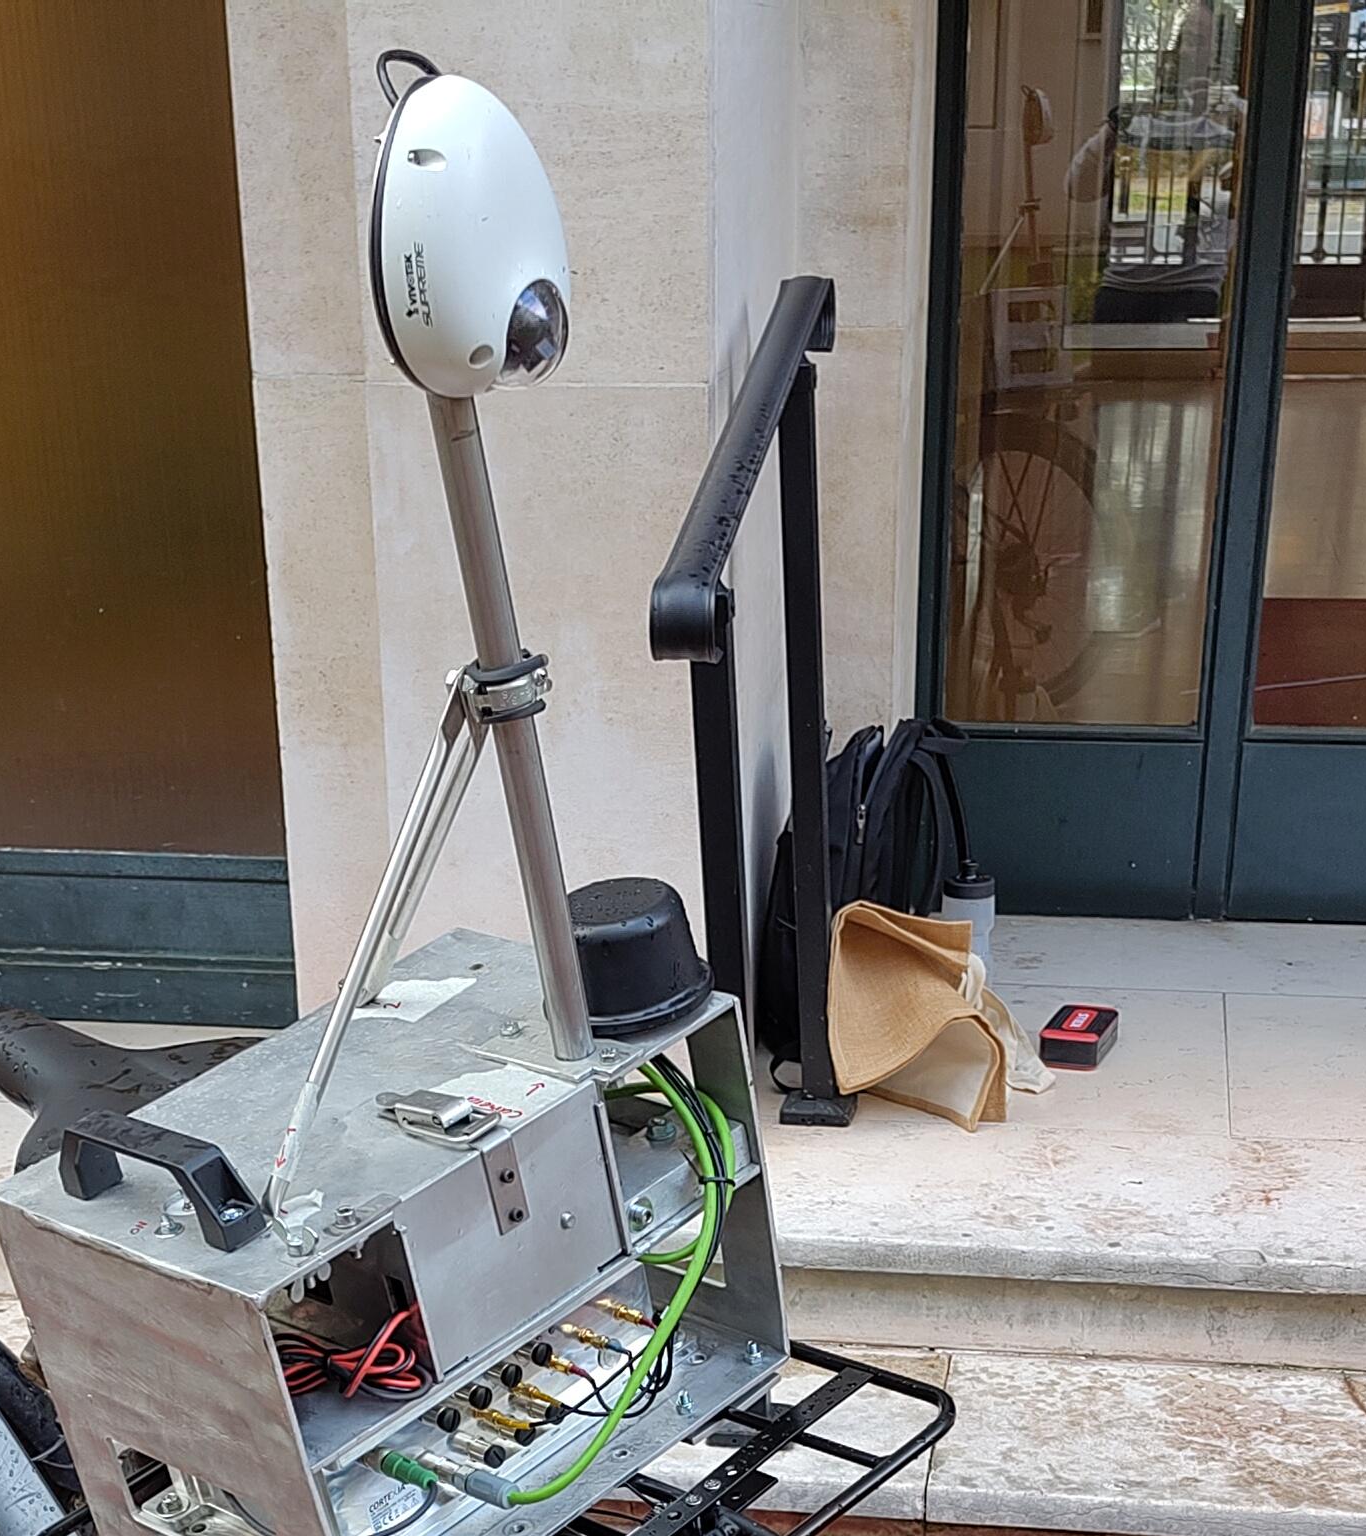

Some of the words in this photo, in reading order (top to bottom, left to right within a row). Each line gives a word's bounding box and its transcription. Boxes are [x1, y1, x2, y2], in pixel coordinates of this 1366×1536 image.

[403, 253, 417, 306] VIVOTEK
[413, 241, 433, 328] SUPREME
[368, 1483, 406, 1514] CORTEXIA
